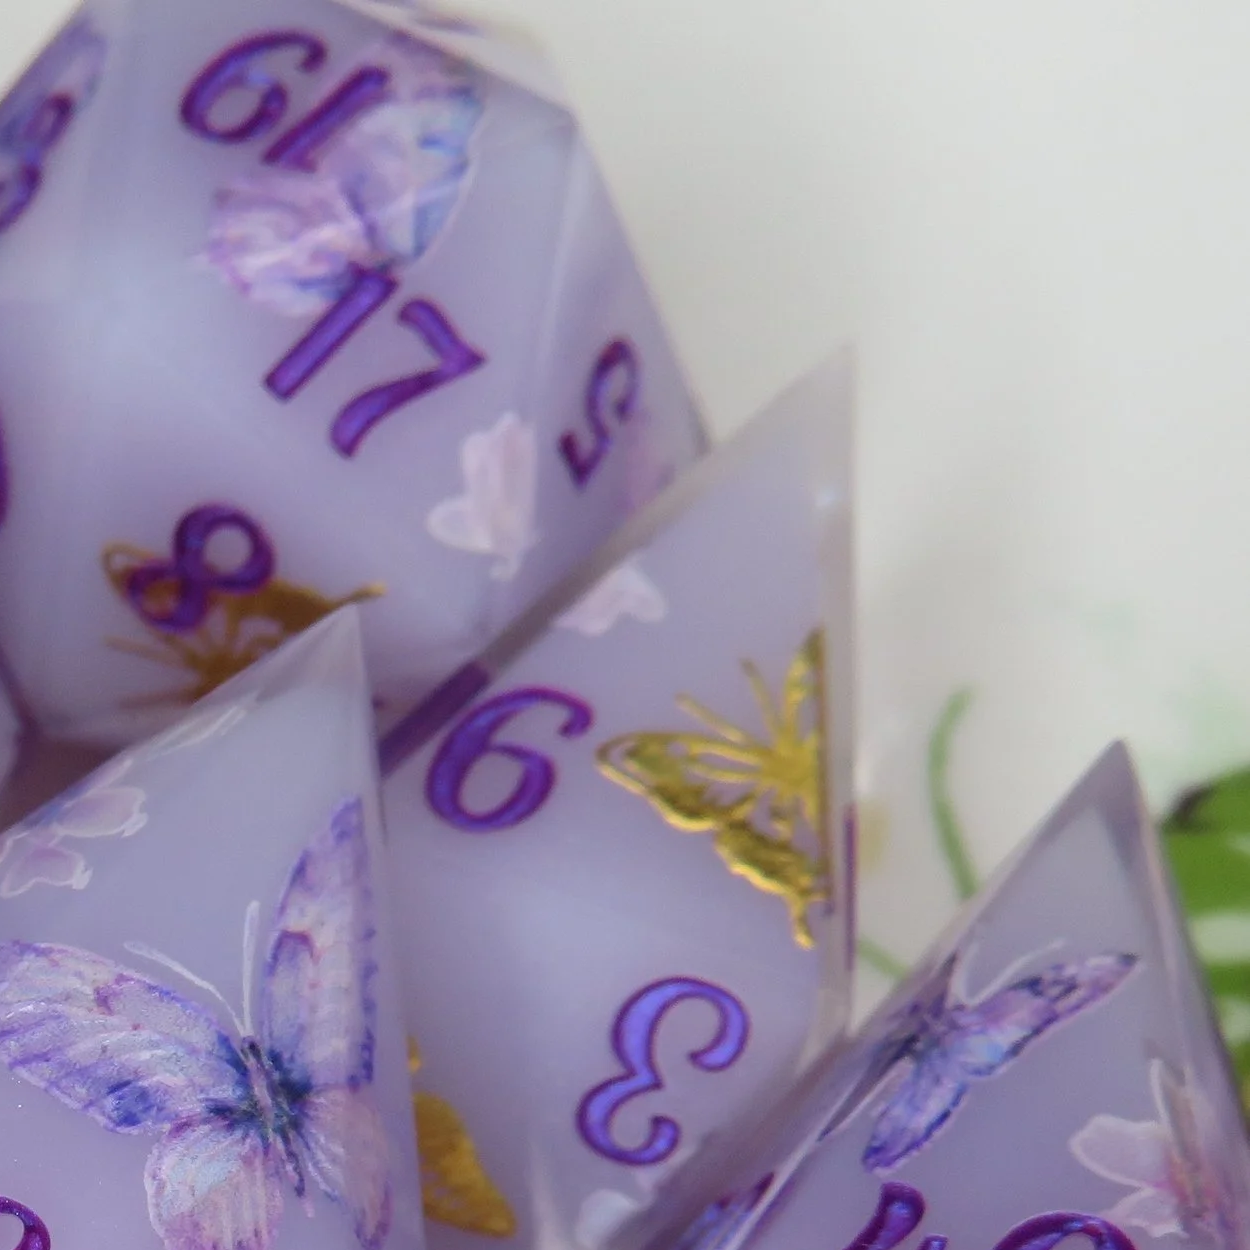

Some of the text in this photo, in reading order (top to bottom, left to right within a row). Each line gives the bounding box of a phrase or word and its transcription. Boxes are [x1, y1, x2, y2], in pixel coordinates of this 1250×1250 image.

[263, 262, 487, 458] 17
[124, 503, 276, 633] 8
[424, 688, 595, 833] 6
[576, 976, 750, 1167] 3
